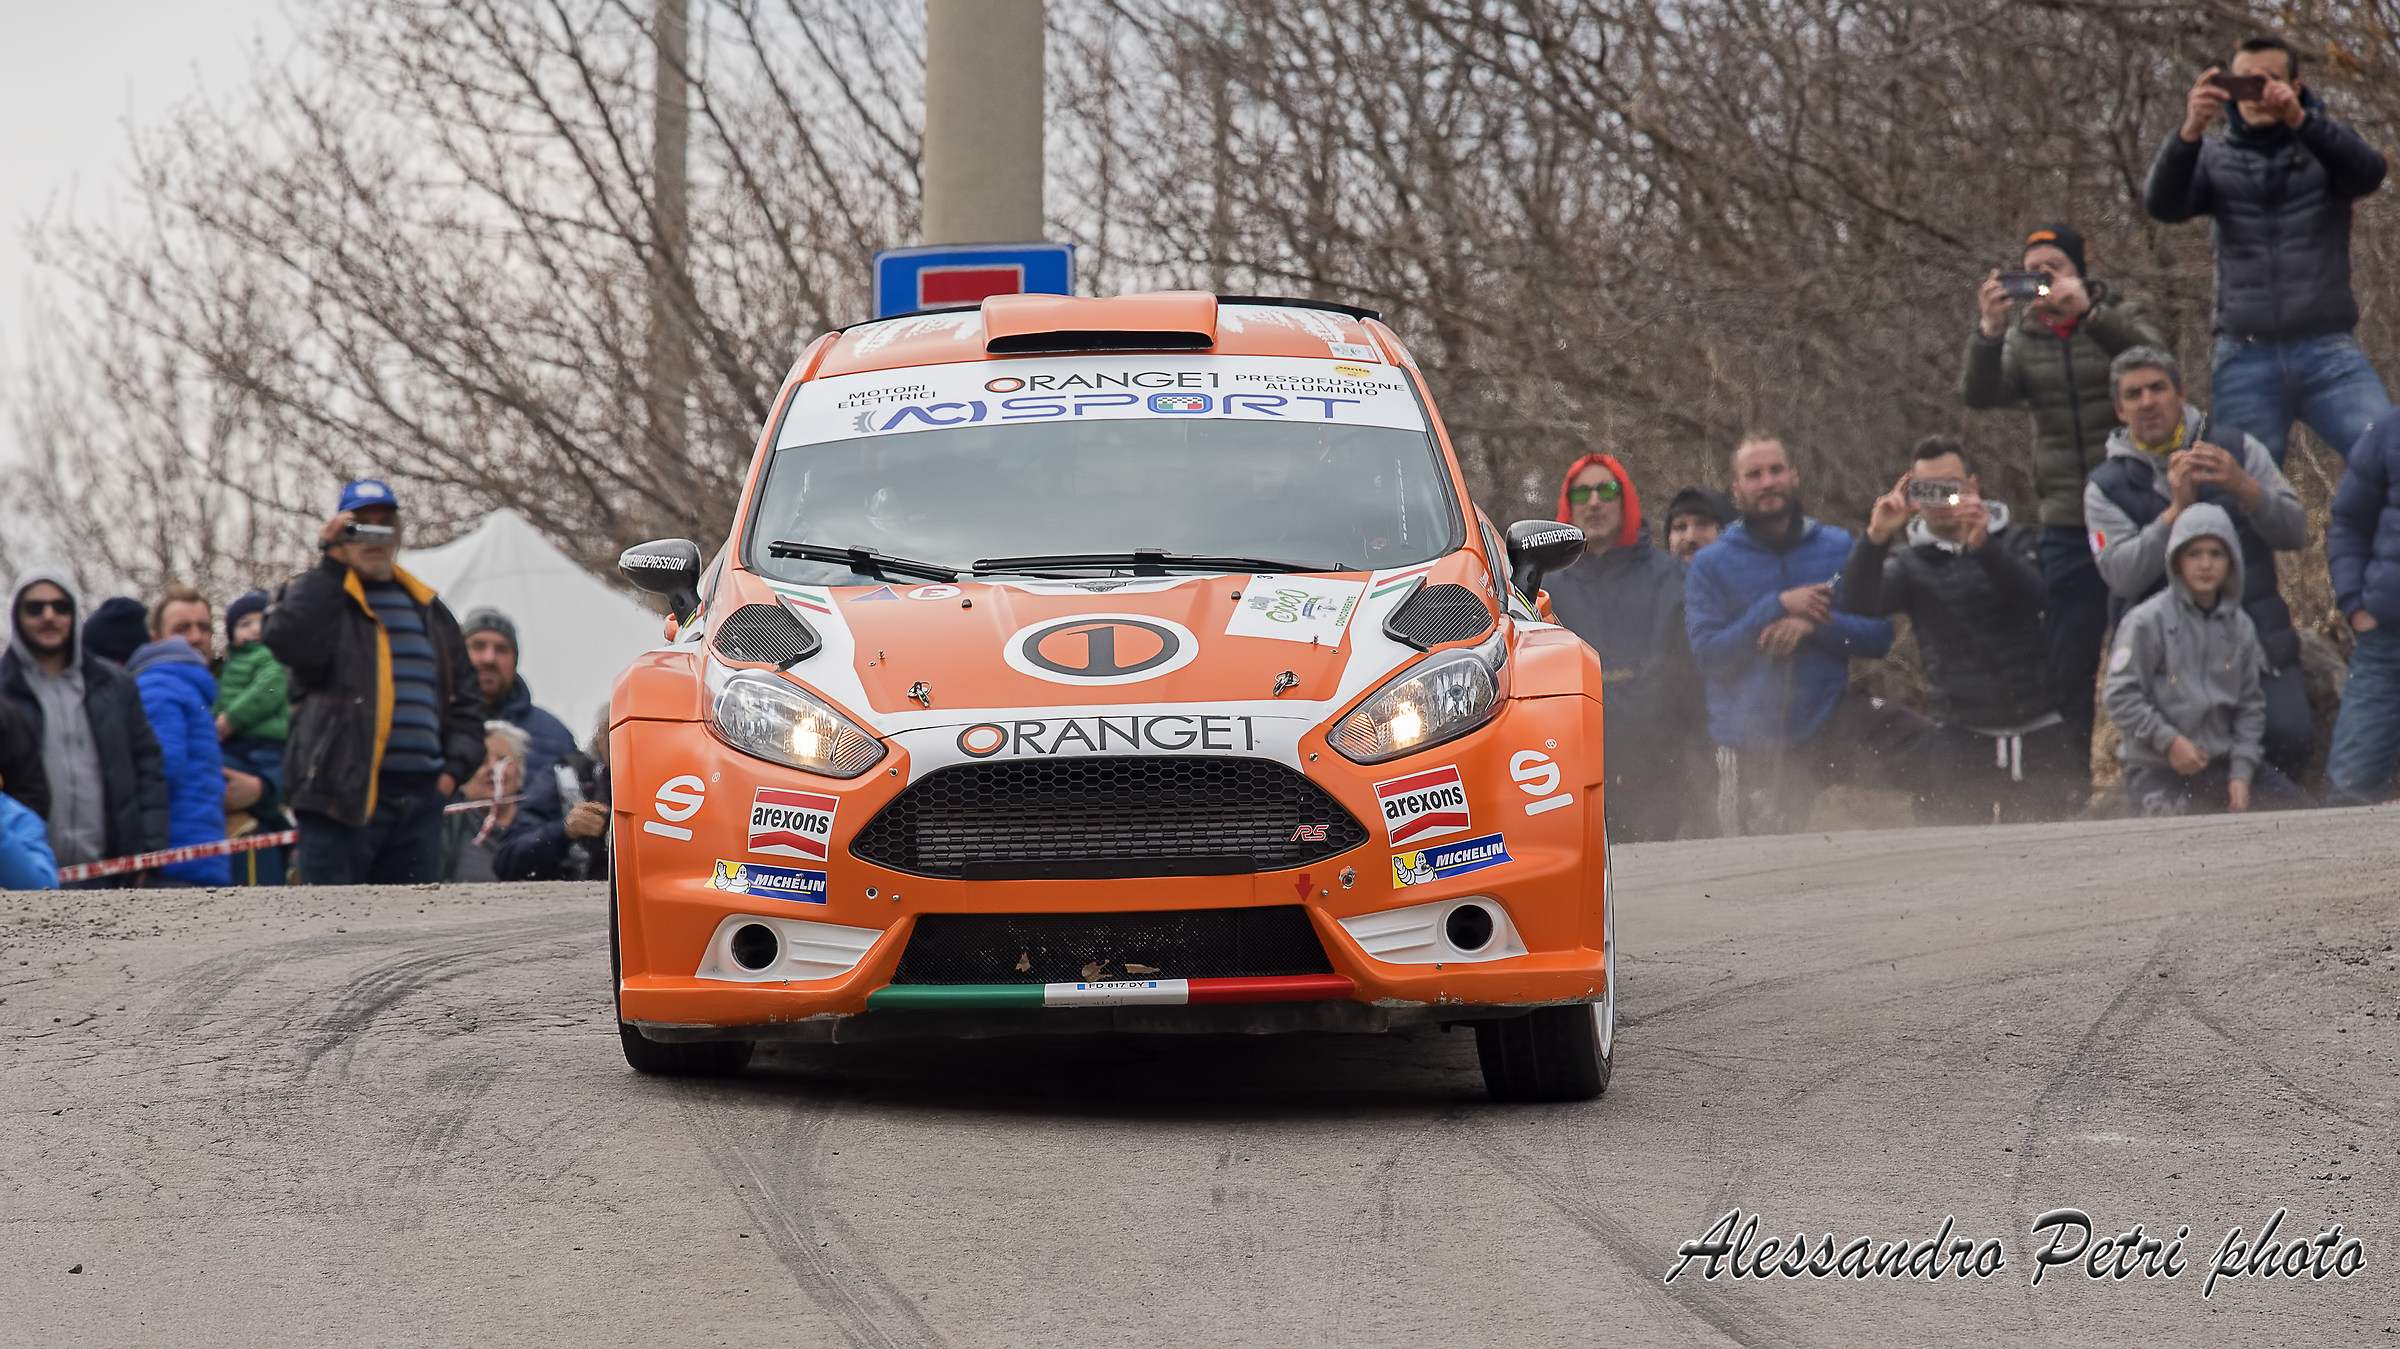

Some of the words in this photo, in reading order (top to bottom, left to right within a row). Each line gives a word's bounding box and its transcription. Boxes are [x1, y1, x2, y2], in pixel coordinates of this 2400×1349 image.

[849, 384, 926, 400] MOTORI
[984, 372, 1219, 393] ORANGE1
[1235, 374, 1405, 392] PRESSOFUSIONE
[1265, 383, 1378, 396] ALLUMINIO
[838, 391, 936, 409] ELETTRICI
[1002, 393, 1361, 420] SPORT
[623, 554, 687, 571] WEAREPASSION
[919, 588, 948, 598] E
[1335, 595, 1357, 627] CONCORRENTE
[956, 715, 1254, 759] ORANGE1
[1384, 785, 1464, 820] arexons
[752, 807, 830, 835] arexons
[1290, 824, 1329, 842] RS
[1435, 841, 1504, 868] MICHELIN
[753, 873, 826, 893] MICHELIN
